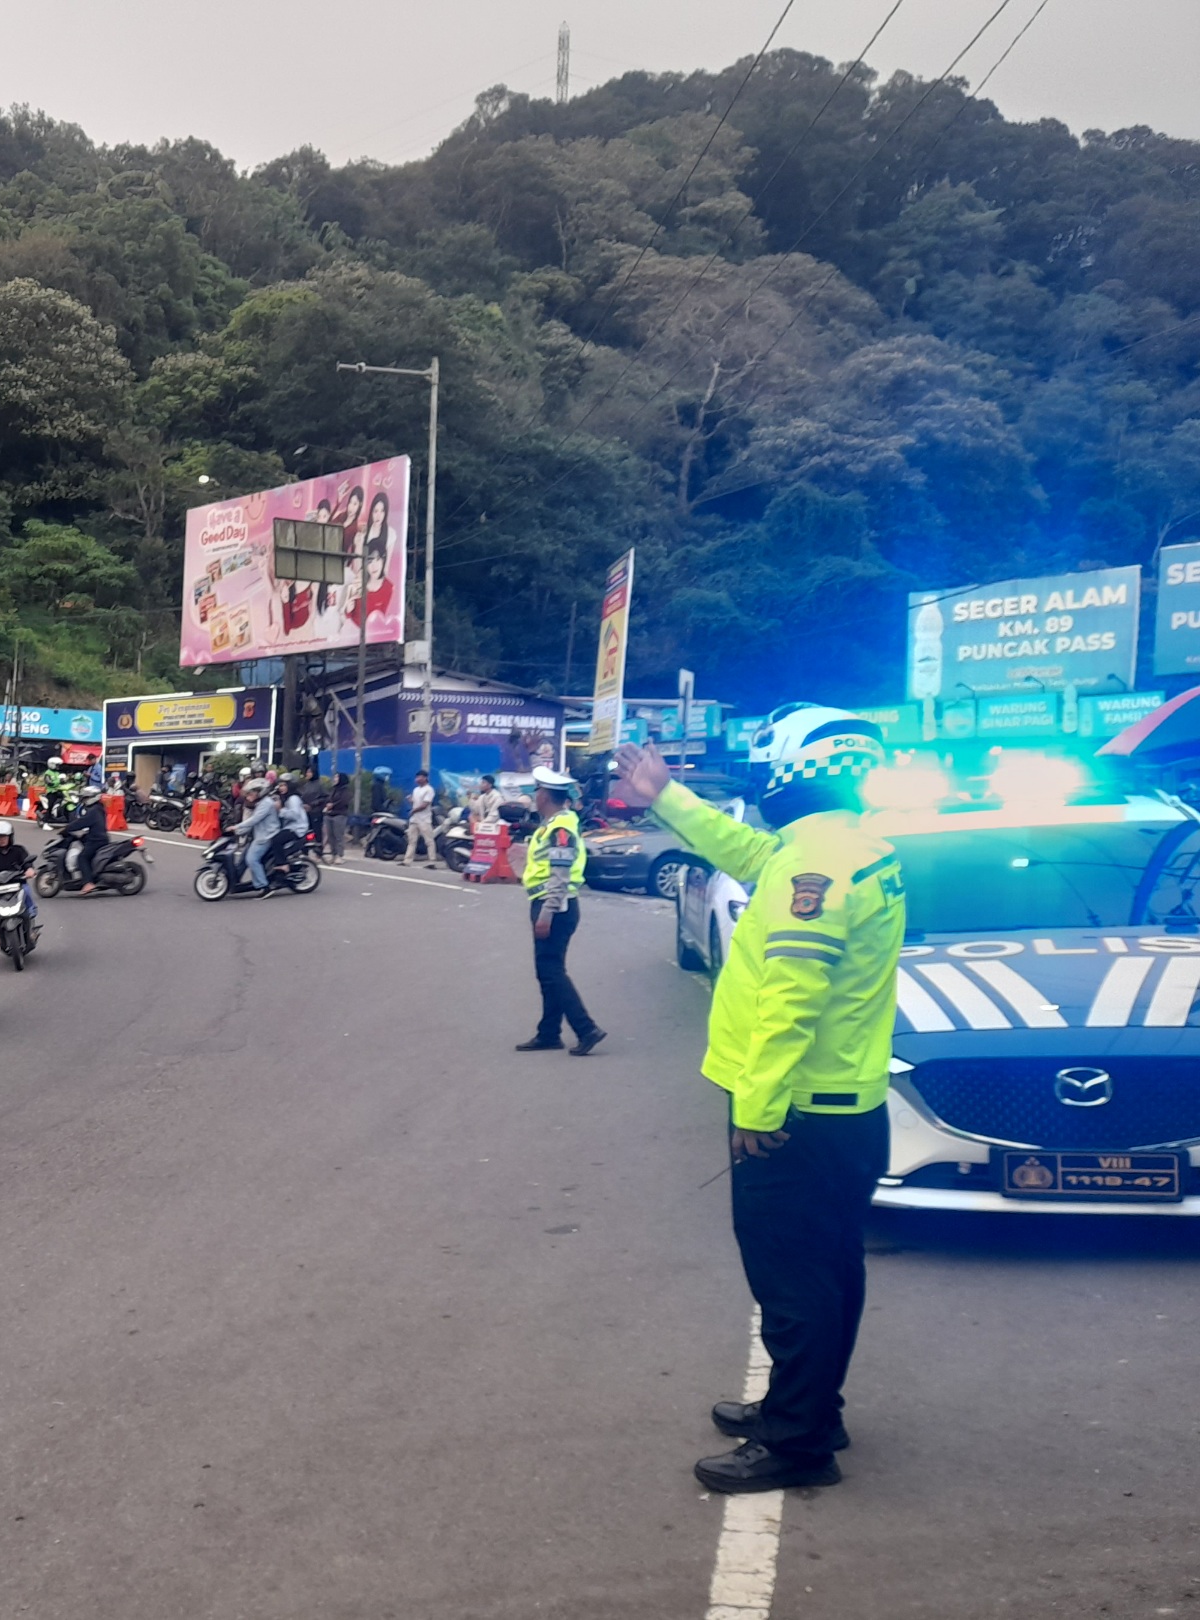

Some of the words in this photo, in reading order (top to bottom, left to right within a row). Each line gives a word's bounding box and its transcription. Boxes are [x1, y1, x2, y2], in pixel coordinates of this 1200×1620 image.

[953, 594, 1039, 623] SEGER
[1044, 583, 1128, 613] ALAM
[998, 618, 1041, 638] KM.
[1045, 614, 1074, 634] 89
[957, 637, 1051, 662] PUNCAK
[1055, 630, 1116, 654] PASS
[988, 702, 1047, 716] WARUNG
[1097, 696, 1162, 712] WARUNG
[466, 713, 488, 727] POS
[1098, 1156, 1131, 1169] VIII
